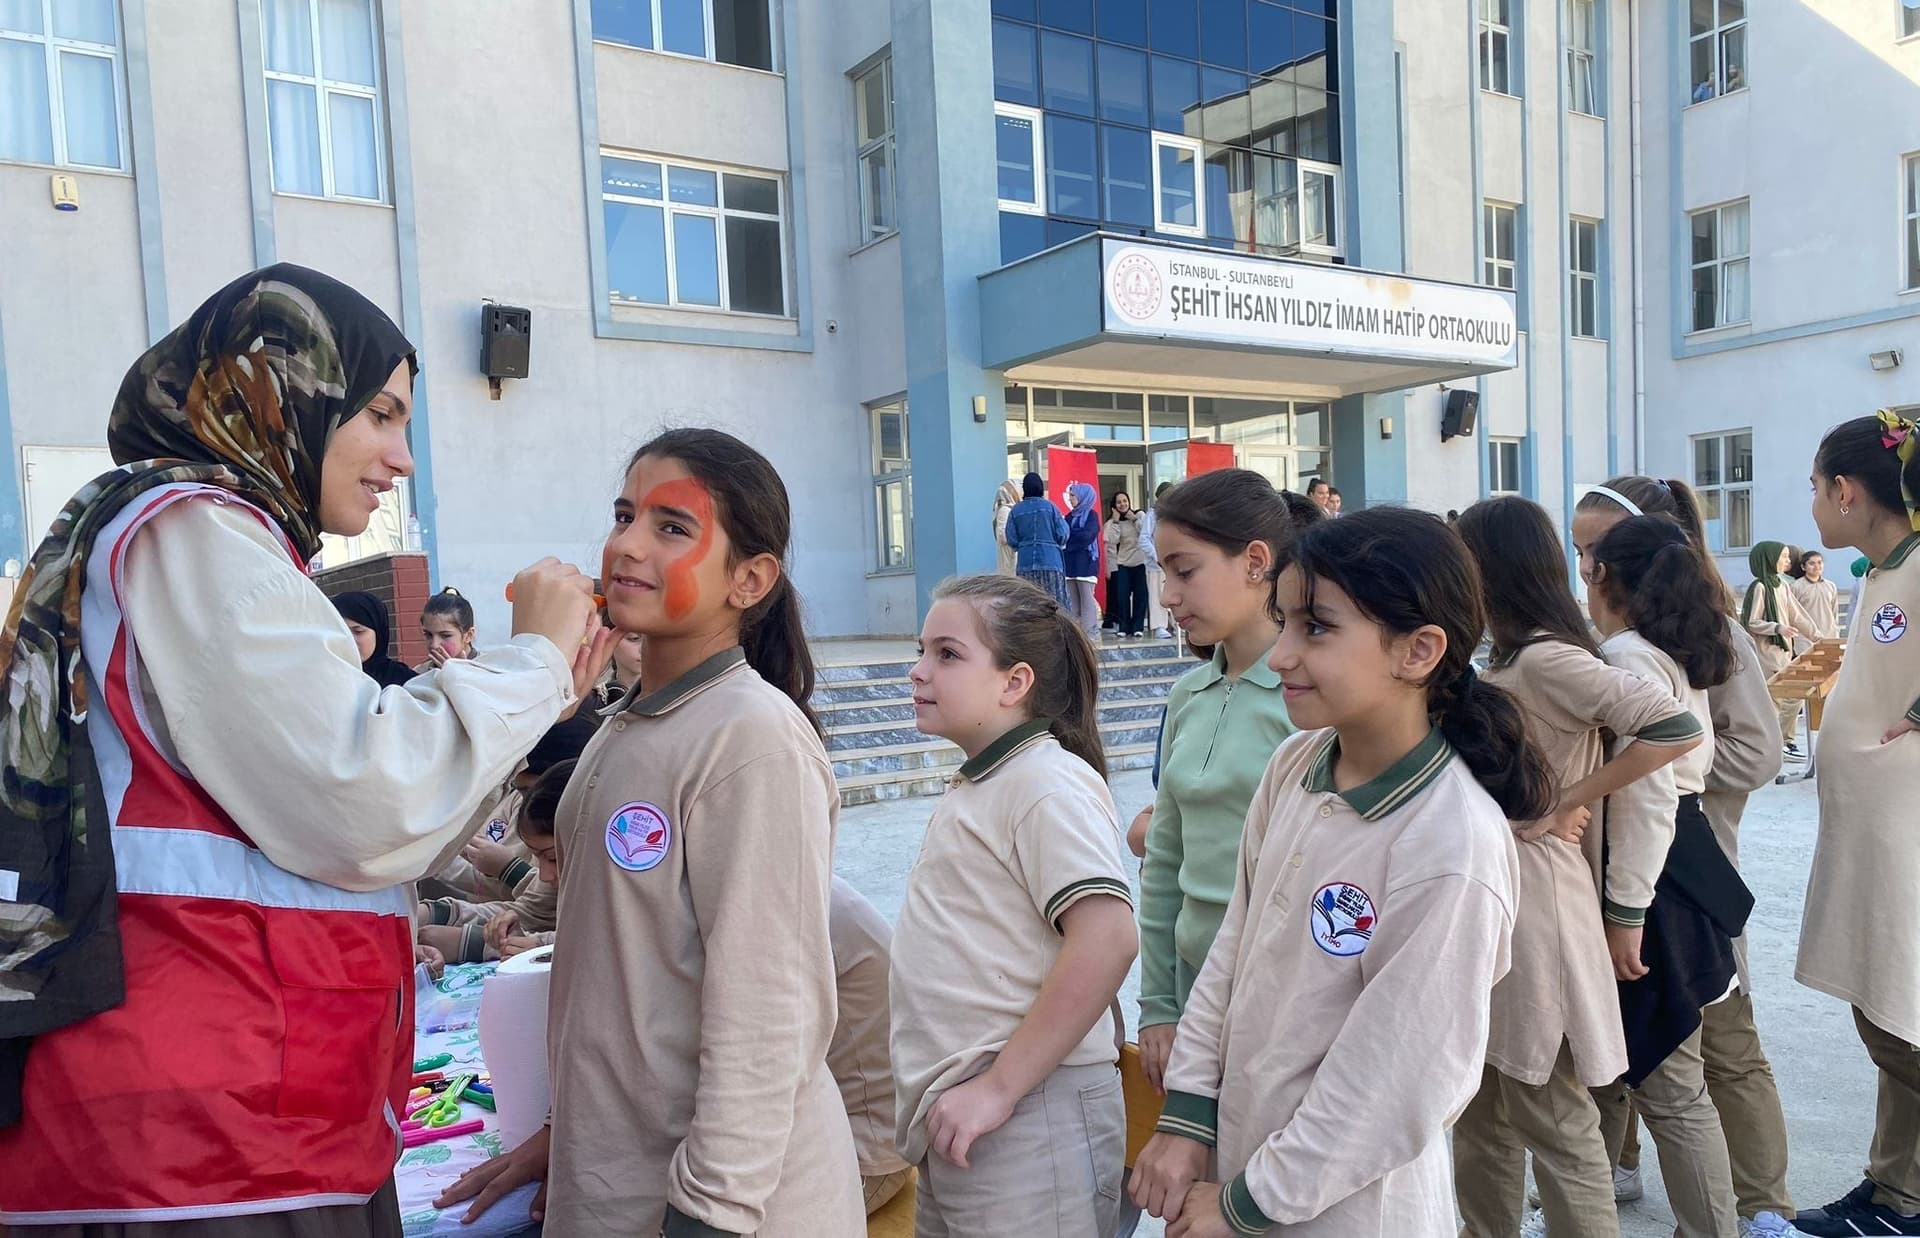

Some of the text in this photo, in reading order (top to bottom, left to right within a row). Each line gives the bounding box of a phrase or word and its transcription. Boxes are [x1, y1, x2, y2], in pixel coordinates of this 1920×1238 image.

[1169, 260, 1220, 281] İSTANBUL
[1229, 270, 1294, 289] SULTANBEYLİ
[1170, 282, 1221, 321] ŞEHİT
[1225, 285, 1277, 323] İHSAN
[1283, 297, 1332, 329] YILDIZ
[1336, 297, 1380, 334] İMAM
[1383, 306, 1425, 337] HATİP
[1428, 314, 1511, 346] ORTAOKULU
